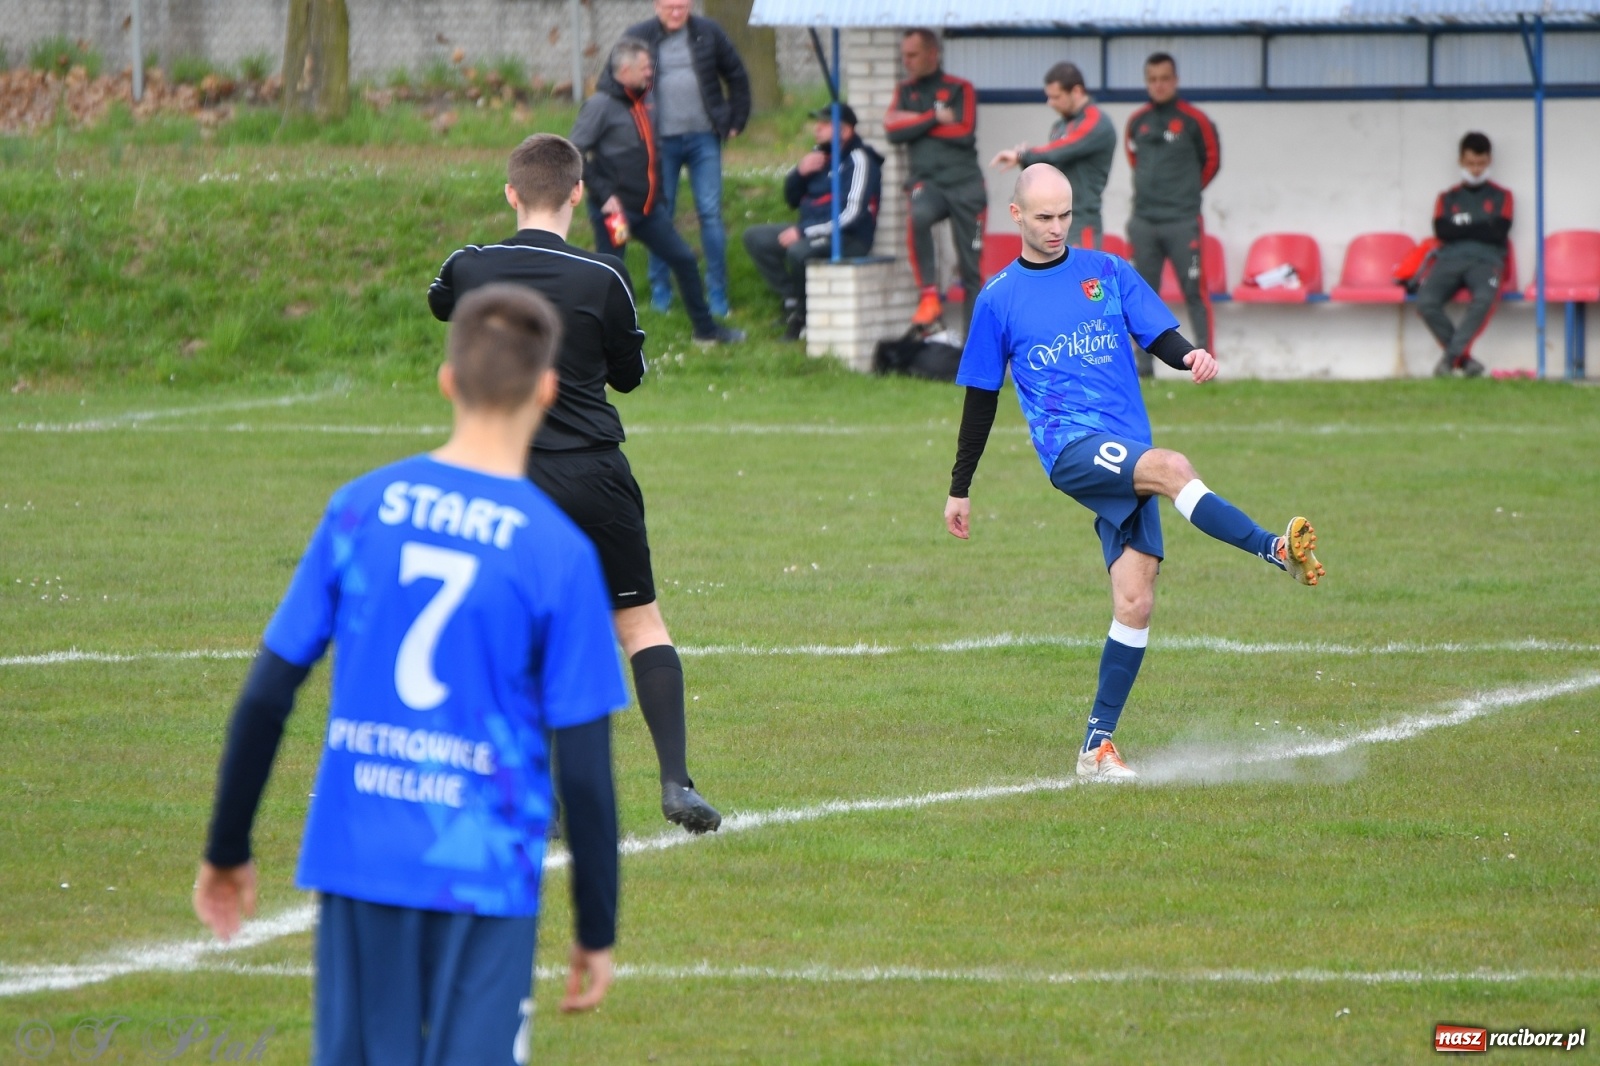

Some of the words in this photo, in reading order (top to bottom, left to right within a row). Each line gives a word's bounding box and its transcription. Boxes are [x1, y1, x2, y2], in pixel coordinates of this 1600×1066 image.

[1027, 332, 1119, 371] Wiktoria
[1093, 441, 1128, 475] 10
[378, 480, 530, 549] START
[394, 541, 480, 711] 7
[328, 718, 496, 775] PIETROWICE
[354, 760, 465, 808] WIELKIE
